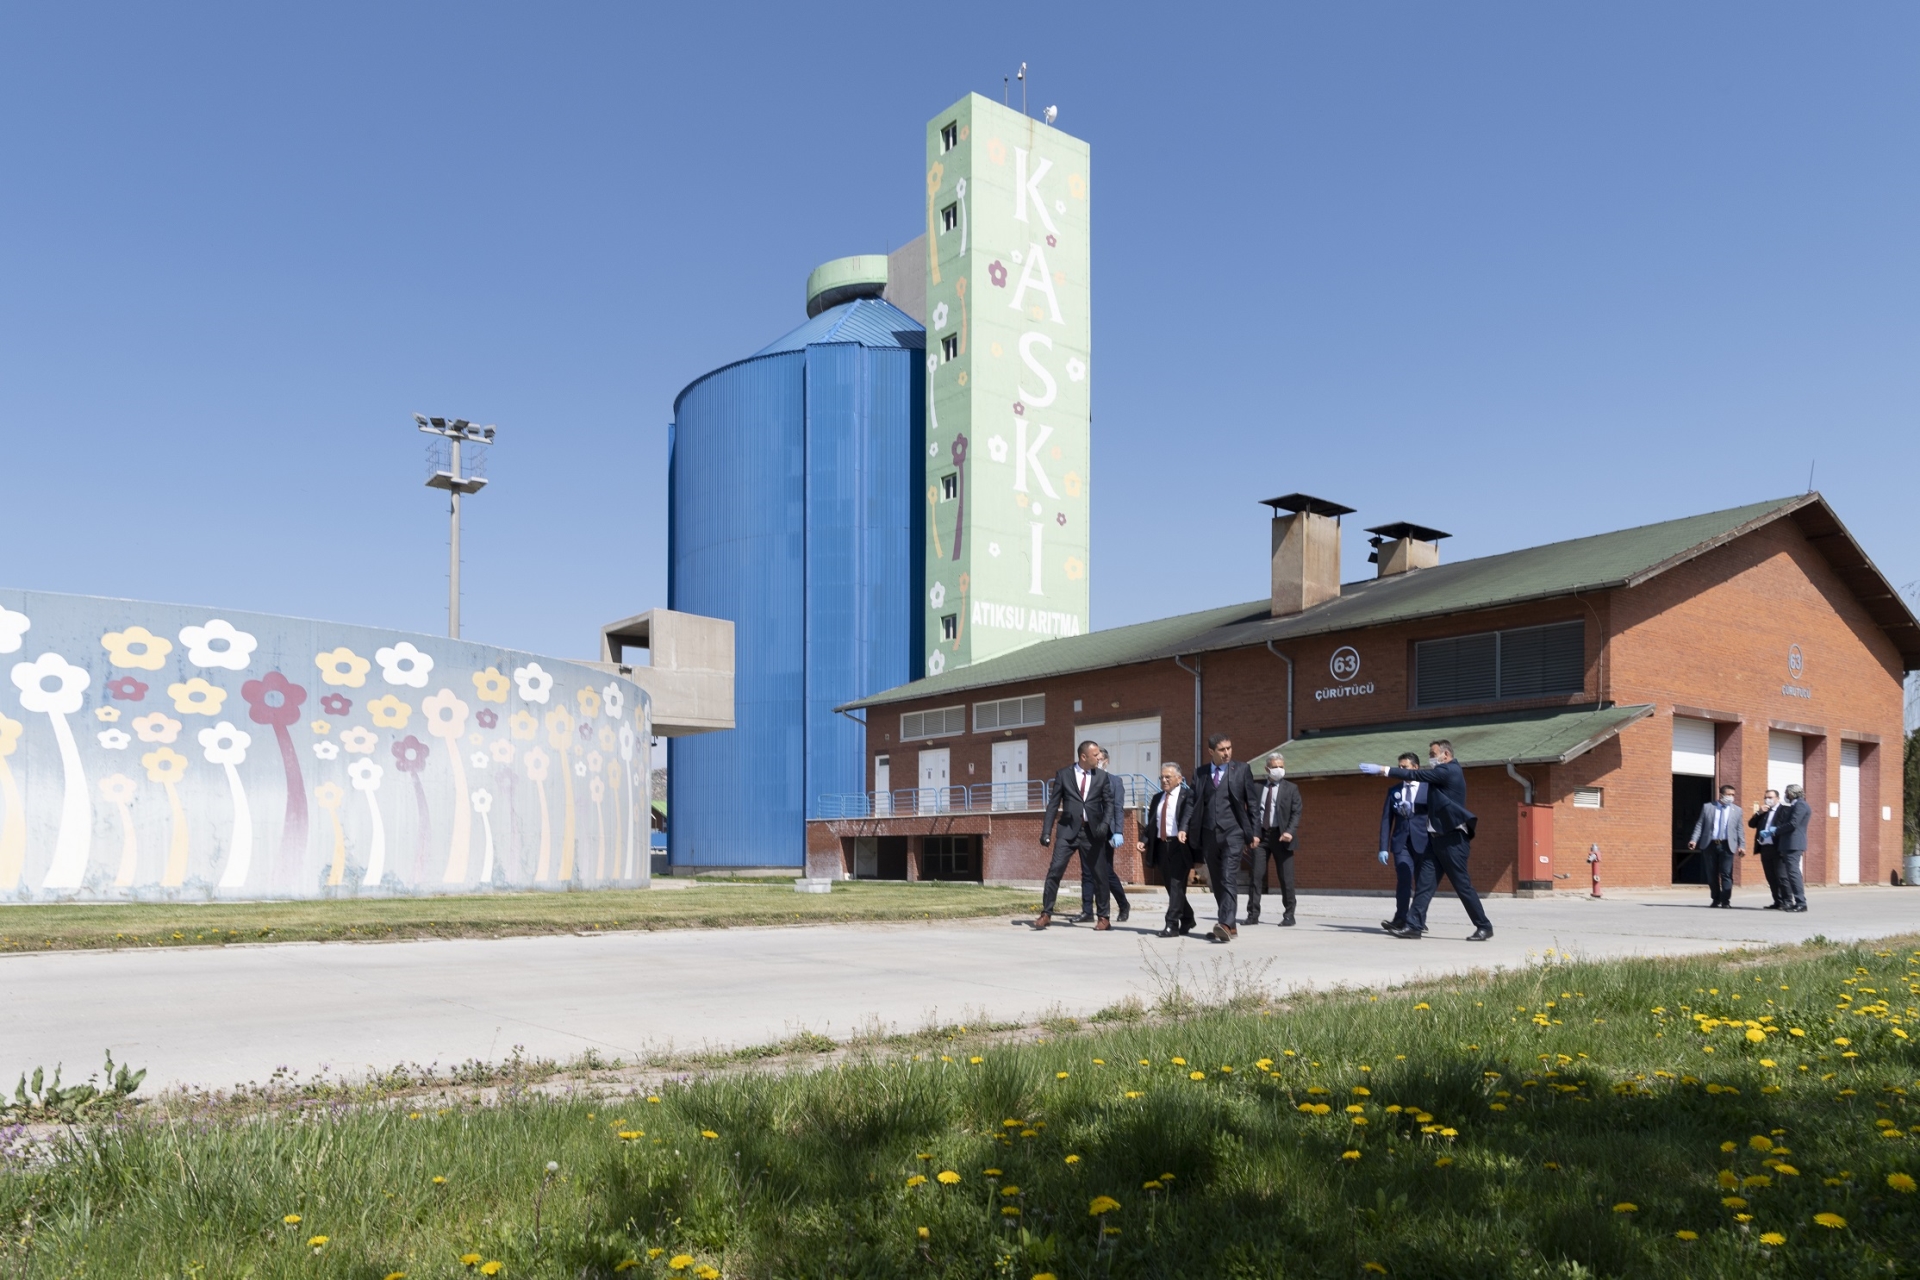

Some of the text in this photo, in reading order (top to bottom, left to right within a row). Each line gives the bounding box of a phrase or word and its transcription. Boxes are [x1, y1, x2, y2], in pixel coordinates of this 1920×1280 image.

[971, 600, 1080, 637] ATIKSU ARITMA
[1333, 655, 1356, 673] 63
[1315, 681, 1374, 702] ÇÜRÜTÜCÜ
